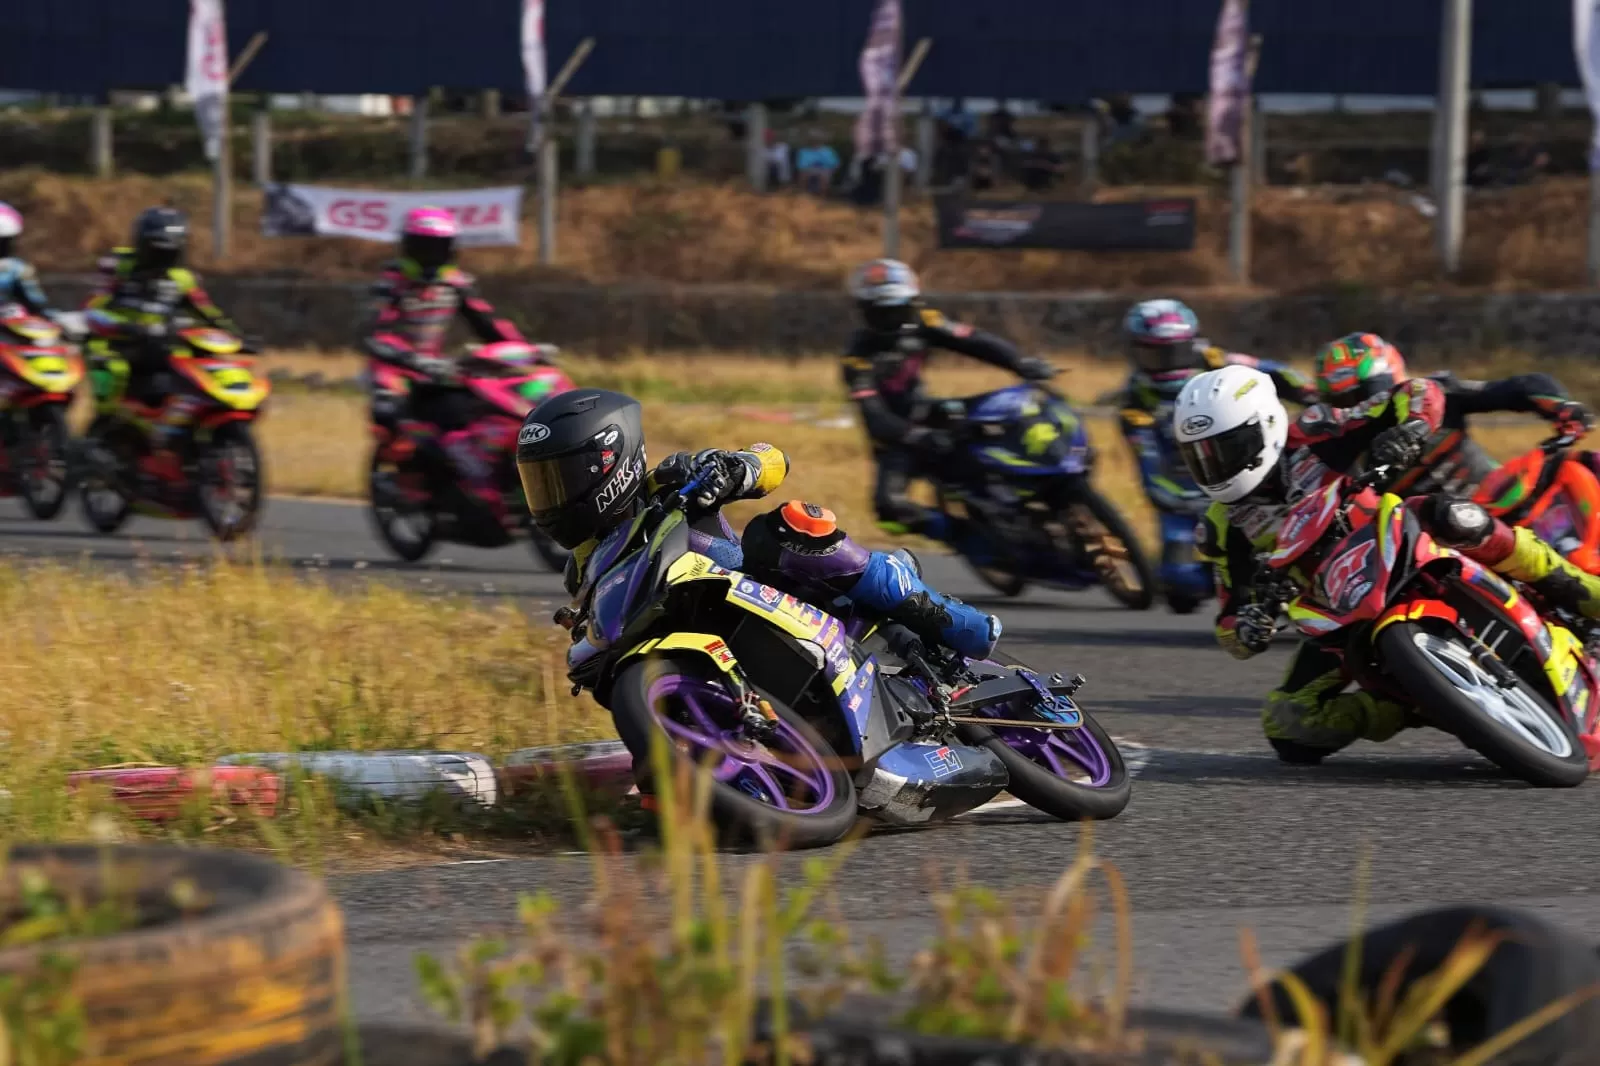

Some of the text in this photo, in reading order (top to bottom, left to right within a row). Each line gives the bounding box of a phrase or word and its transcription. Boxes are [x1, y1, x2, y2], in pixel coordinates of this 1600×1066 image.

[328, 199, 389, 231] GS
[520, 426, 547, 440] NHK
[596, 456, 634, 513] NHK
